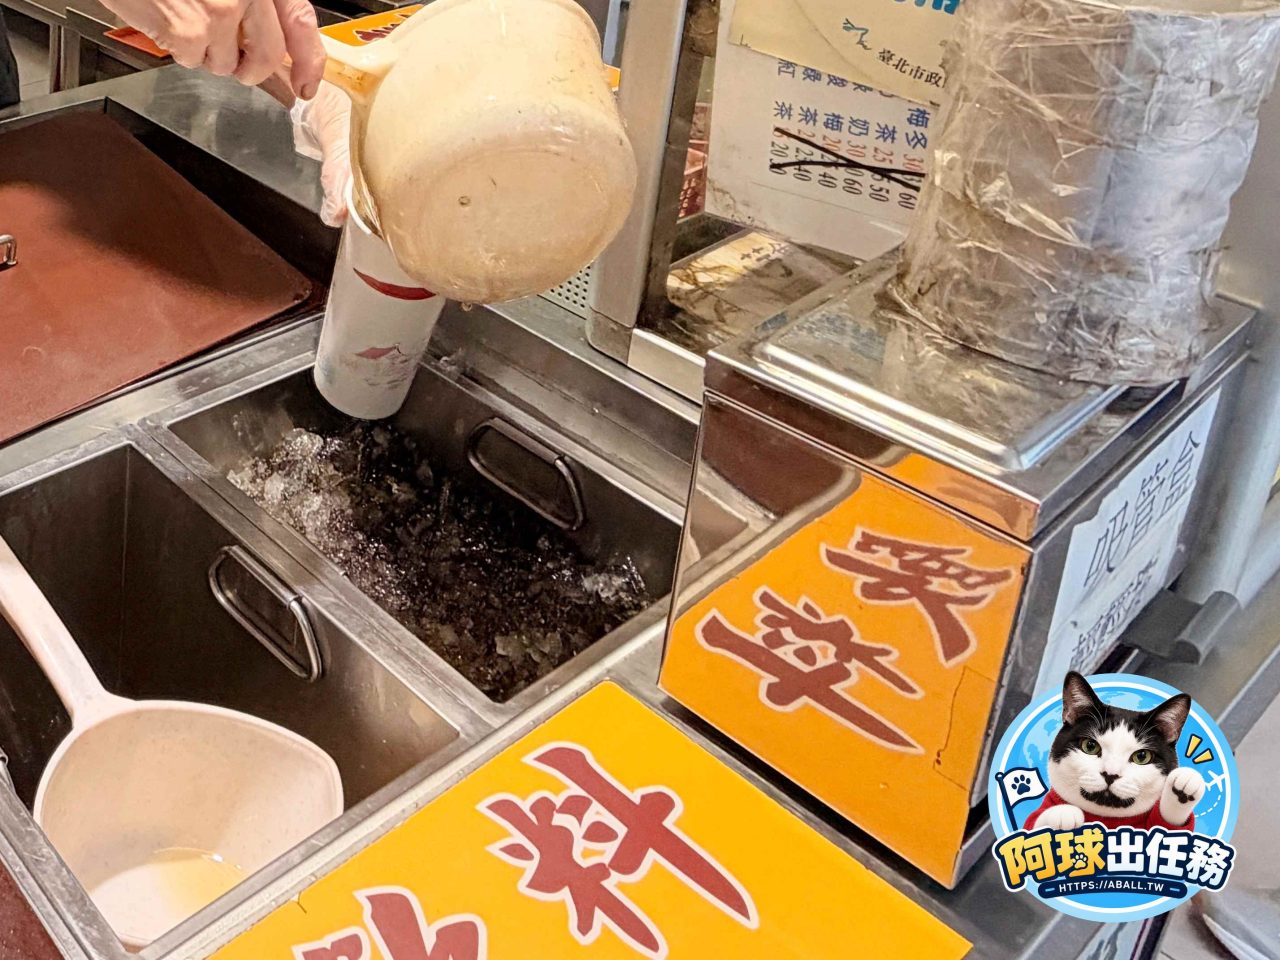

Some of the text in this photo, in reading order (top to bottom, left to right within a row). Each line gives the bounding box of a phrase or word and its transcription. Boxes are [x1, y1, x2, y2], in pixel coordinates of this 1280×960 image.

[878, 48, 946, 89] 臺北市政
[773, 101, 793, 120] 茶
[798, 106, 818, 127] 茶
[875, 123, 897, 144] 茶
[818, 171, 838, 189] 40
[842, 177, 863, 196] 60
[869, 184, 890, 203] 50
[898, 192, 918, 210] 60
[1084, 431, 1200, 588] 吸管盒
